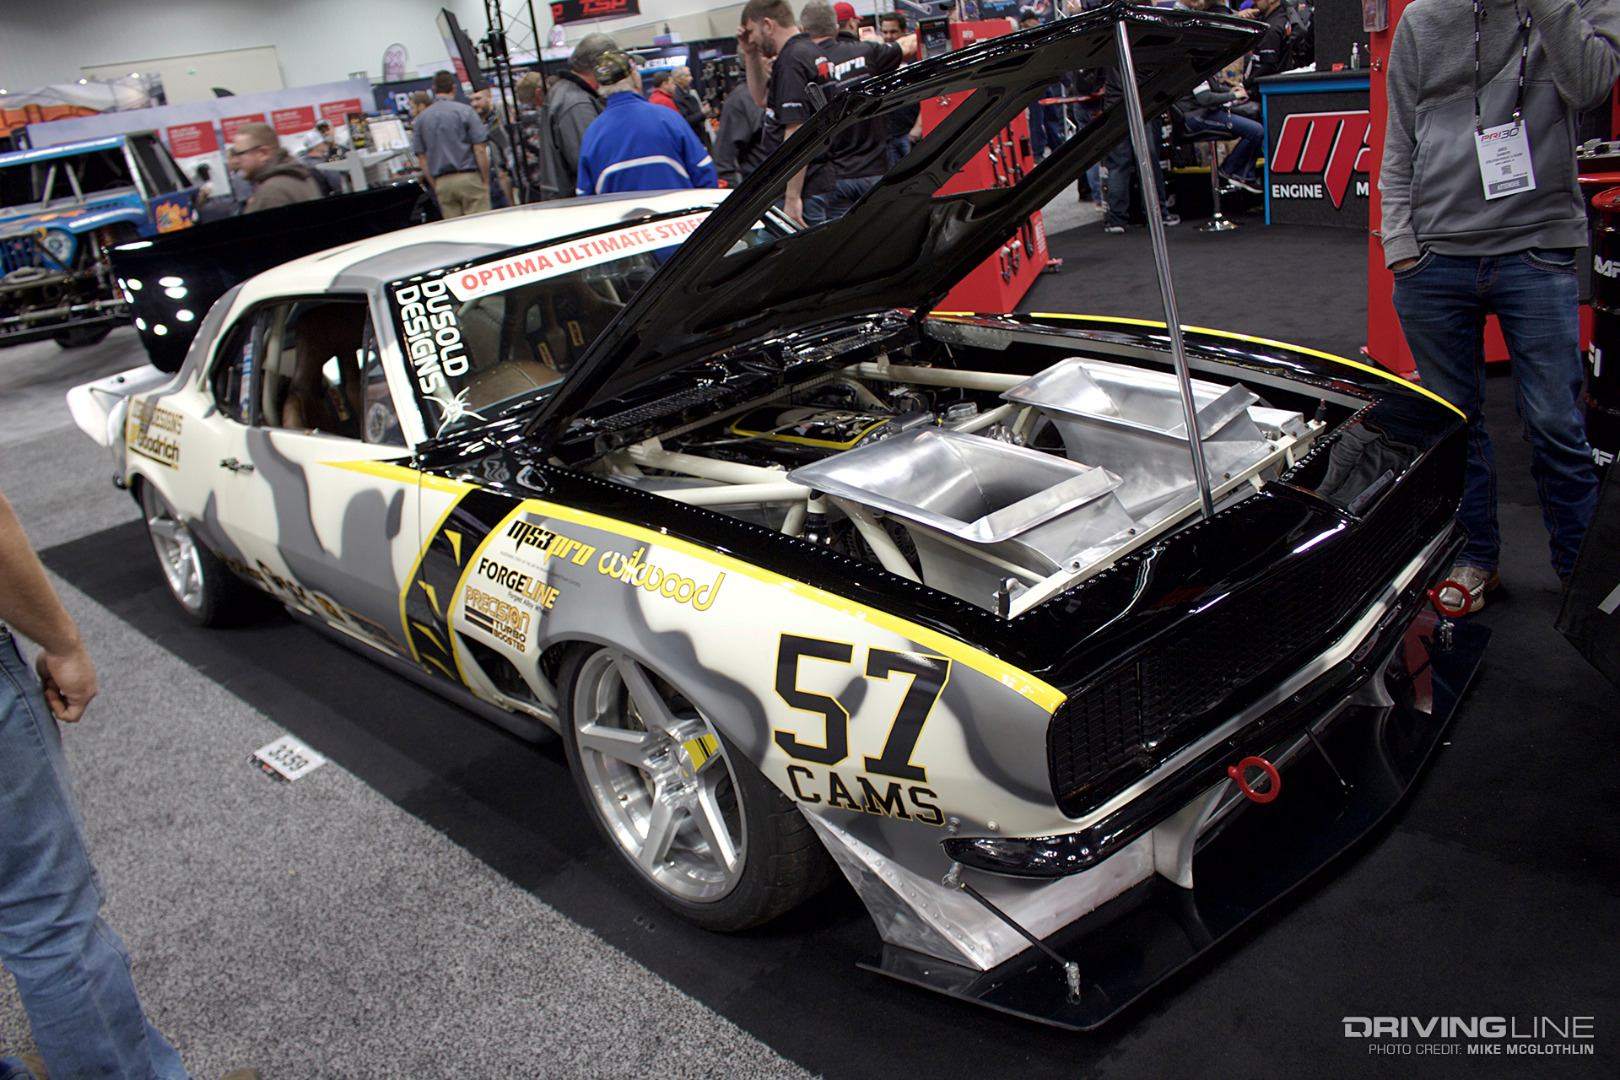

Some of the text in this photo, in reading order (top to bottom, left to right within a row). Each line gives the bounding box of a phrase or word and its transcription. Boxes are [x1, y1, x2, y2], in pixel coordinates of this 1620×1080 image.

[1271, 184, 1323, 198] ENGINE
[460, 256, 555, 292] OPTIMA
[554, 228, 657, 265] ULTIMATE
[420, 278, 470, 377] DUSOLD
[477, 557, 561, 610] FORGELINE
[598, 547, 726, 611] wilwood
[493, 619, 527, 643] TURBO
[493, 629, 526, 653] BOOSTED
[773, 631, 952, 784] 57
[786, 764, 946, 827] CAMS
